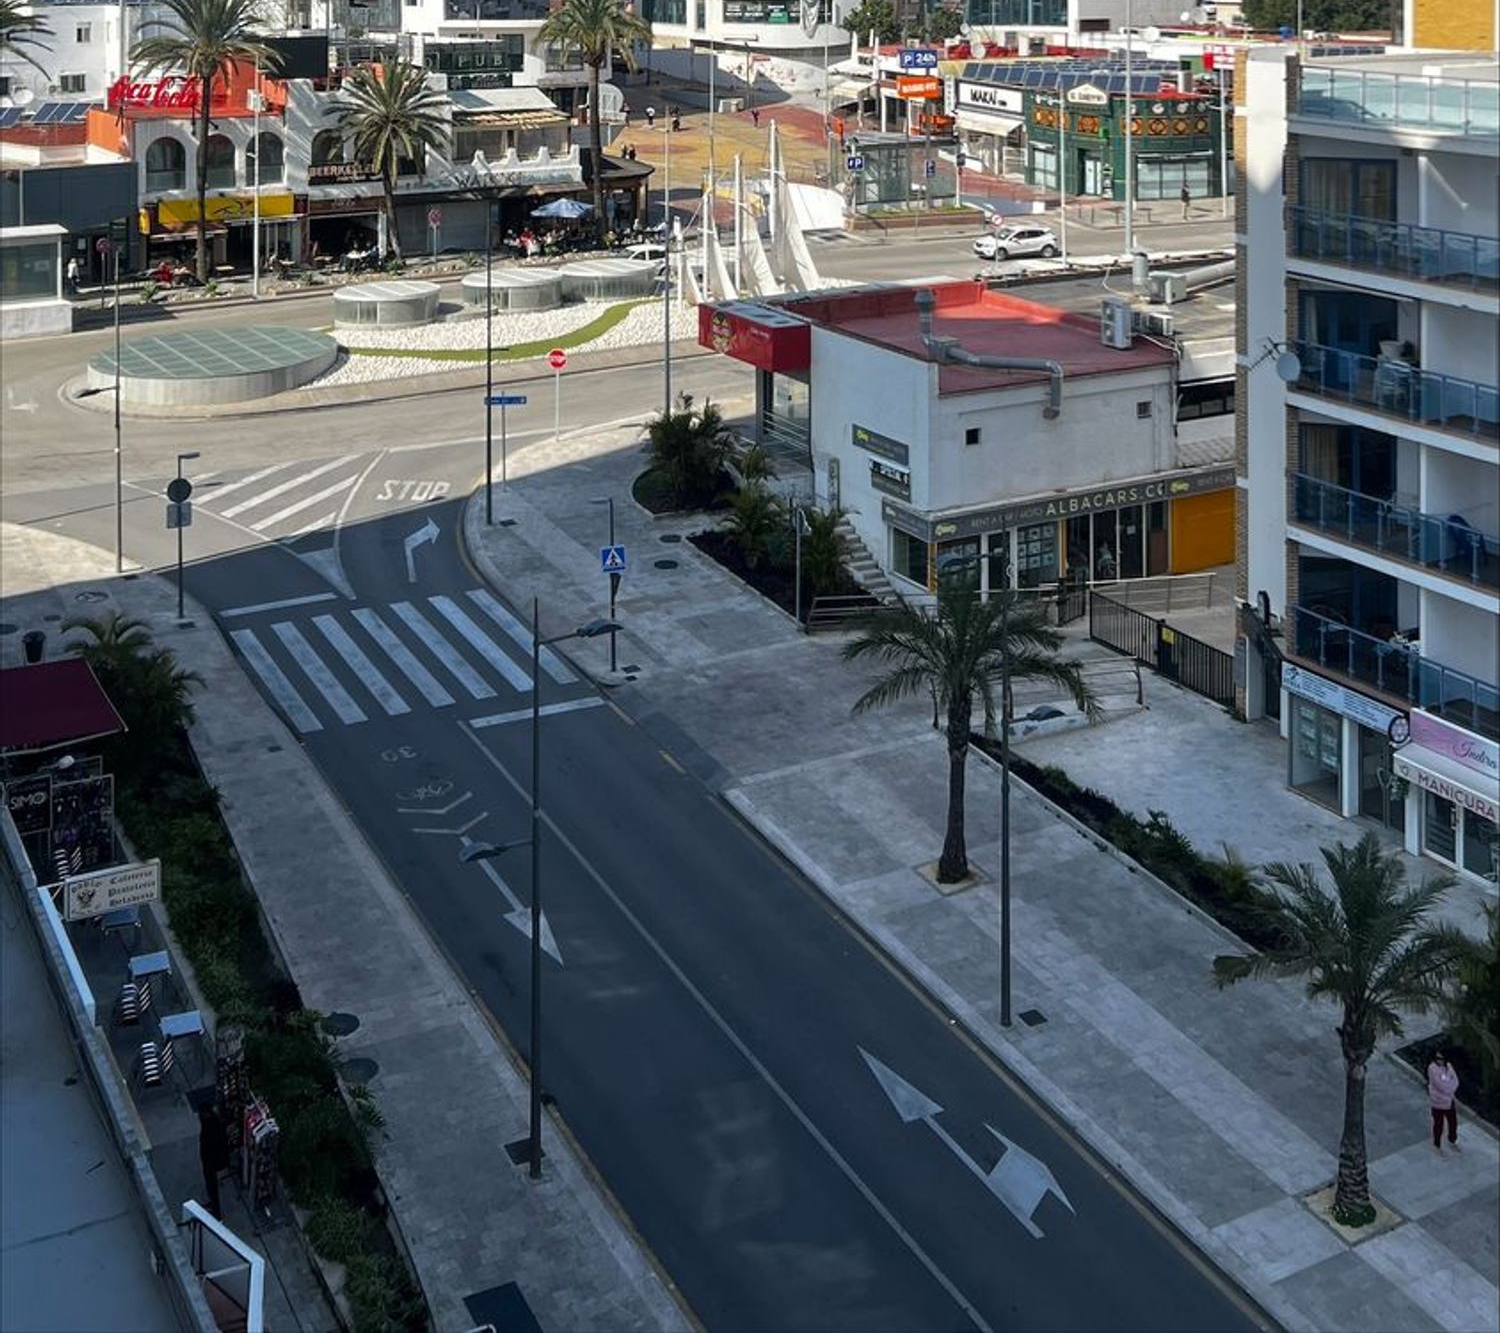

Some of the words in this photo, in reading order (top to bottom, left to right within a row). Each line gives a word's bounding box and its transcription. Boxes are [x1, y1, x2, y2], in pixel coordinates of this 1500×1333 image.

[458, 54, 503, 68] PUB
[915, 52, 936, 65] 24h
[377, 479, 451, 501] STOP
[1418, 771, 1497, 818] MANICURA
